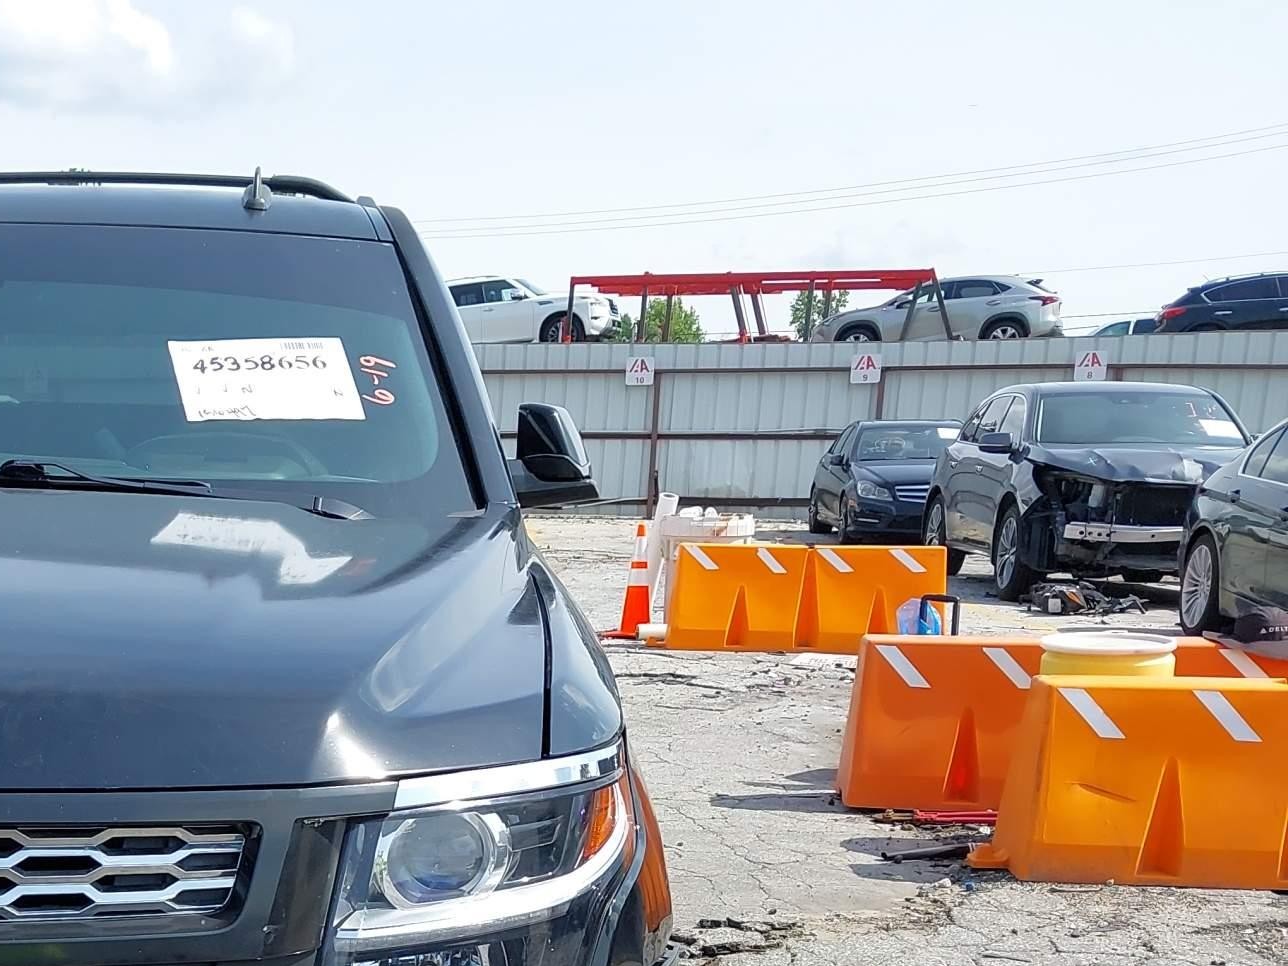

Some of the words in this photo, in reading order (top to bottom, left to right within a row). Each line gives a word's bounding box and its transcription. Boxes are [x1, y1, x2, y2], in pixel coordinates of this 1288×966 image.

[192, 354, 328, 374] 45358656
[862, 374, 868, 382] 9
[1086, 371, 1093, 379] 8
[359, 355, 397, 405] 6-19
[635, 376, 645, 384] 10
